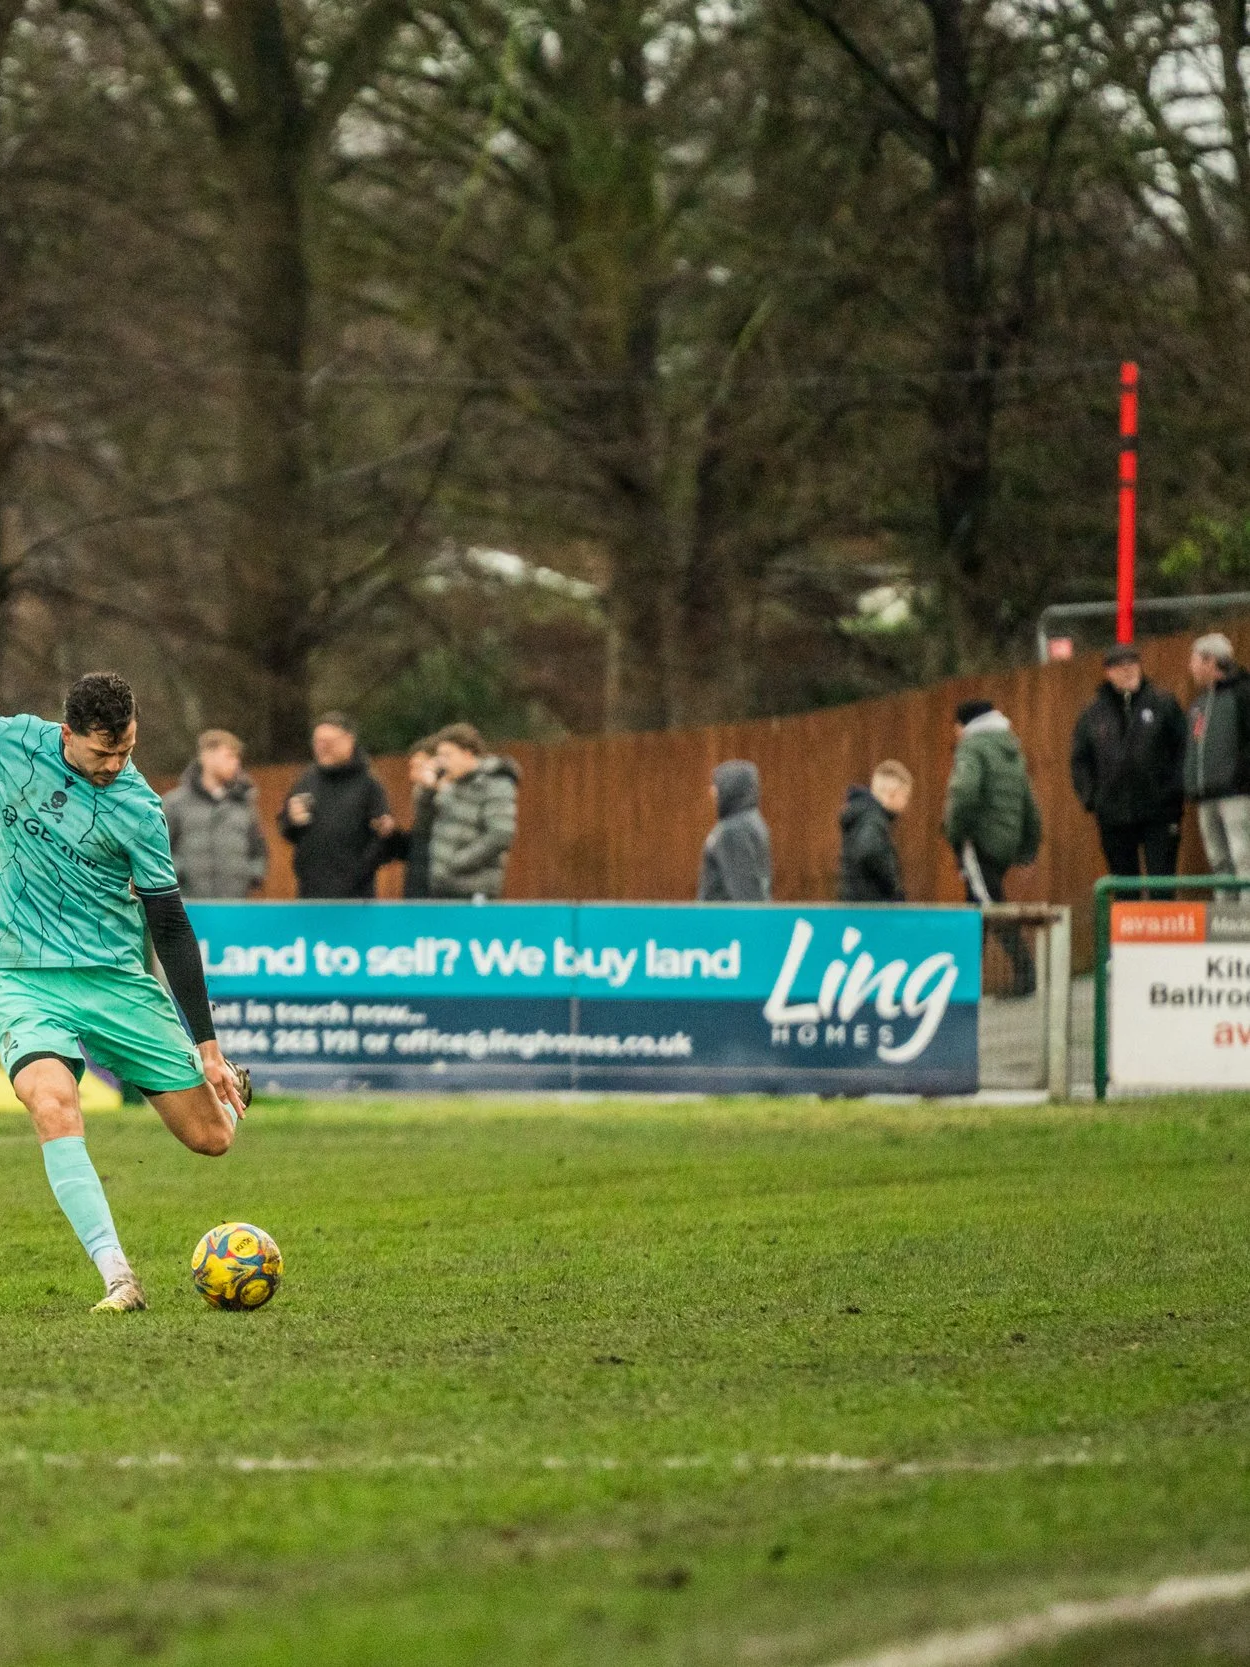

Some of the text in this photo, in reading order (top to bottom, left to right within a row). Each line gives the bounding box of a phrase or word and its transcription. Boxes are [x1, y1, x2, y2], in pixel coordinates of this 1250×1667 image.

[1119, 914, 1196, 935] avanti
[198, 935, 741, 988] Land to sell? We buy land
[763, 917, 960, 1064] Ling
[209, 1001, 242, 1025] et
[245, 1000, 273, 1025] in
[275, 1001, 350, 1025] touch
[362, 1033, 392, 1055] or
[771, 1024, 895, 1047] HOMES
